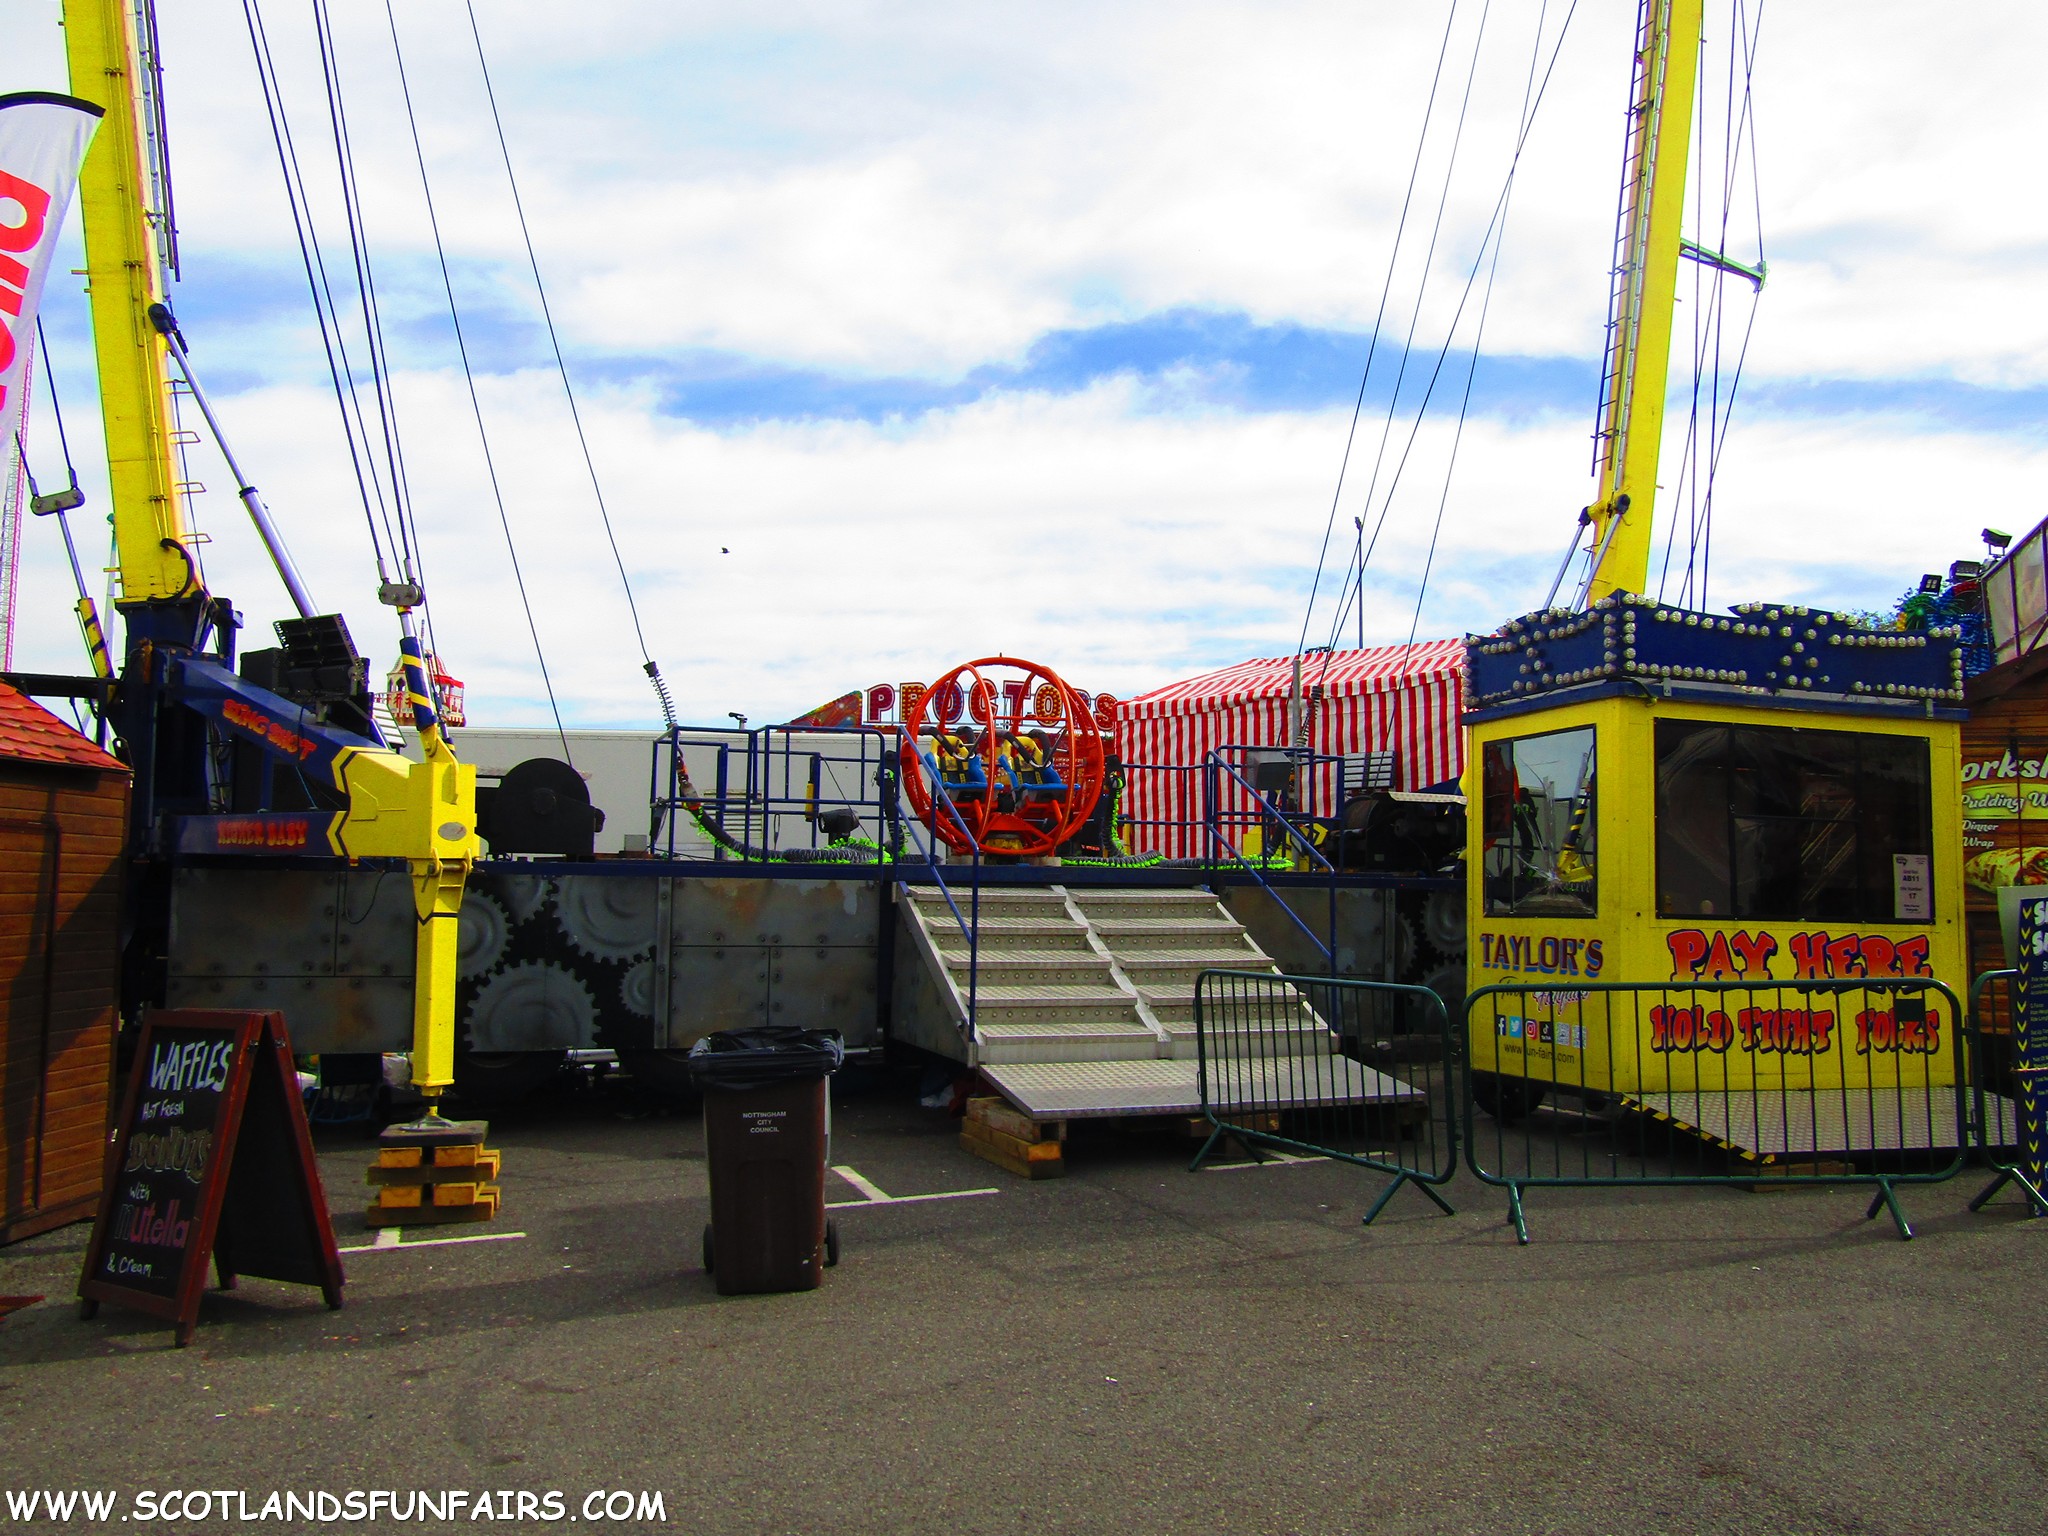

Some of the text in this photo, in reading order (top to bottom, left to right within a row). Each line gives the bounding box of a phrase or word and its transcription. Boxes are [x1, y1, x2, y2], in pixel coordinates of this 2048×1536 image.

[1962, 819, 1999, 832] Dinner
[1962, 836, 1995, 849] Wrap
[1480, 933, 1604, 979] TAYLOR'S
[1666, 929, 1933, 995] PAY HERE
[1650, 1004, 1734, 1054] HOLD
[1737, 1006, 1835, 1055] TIGHT
[150, 1040, 234, 1092] WAFFLES
[160, 1099, 185, 1117] FRESH
[119, 1256, 152, 1278] Cream
